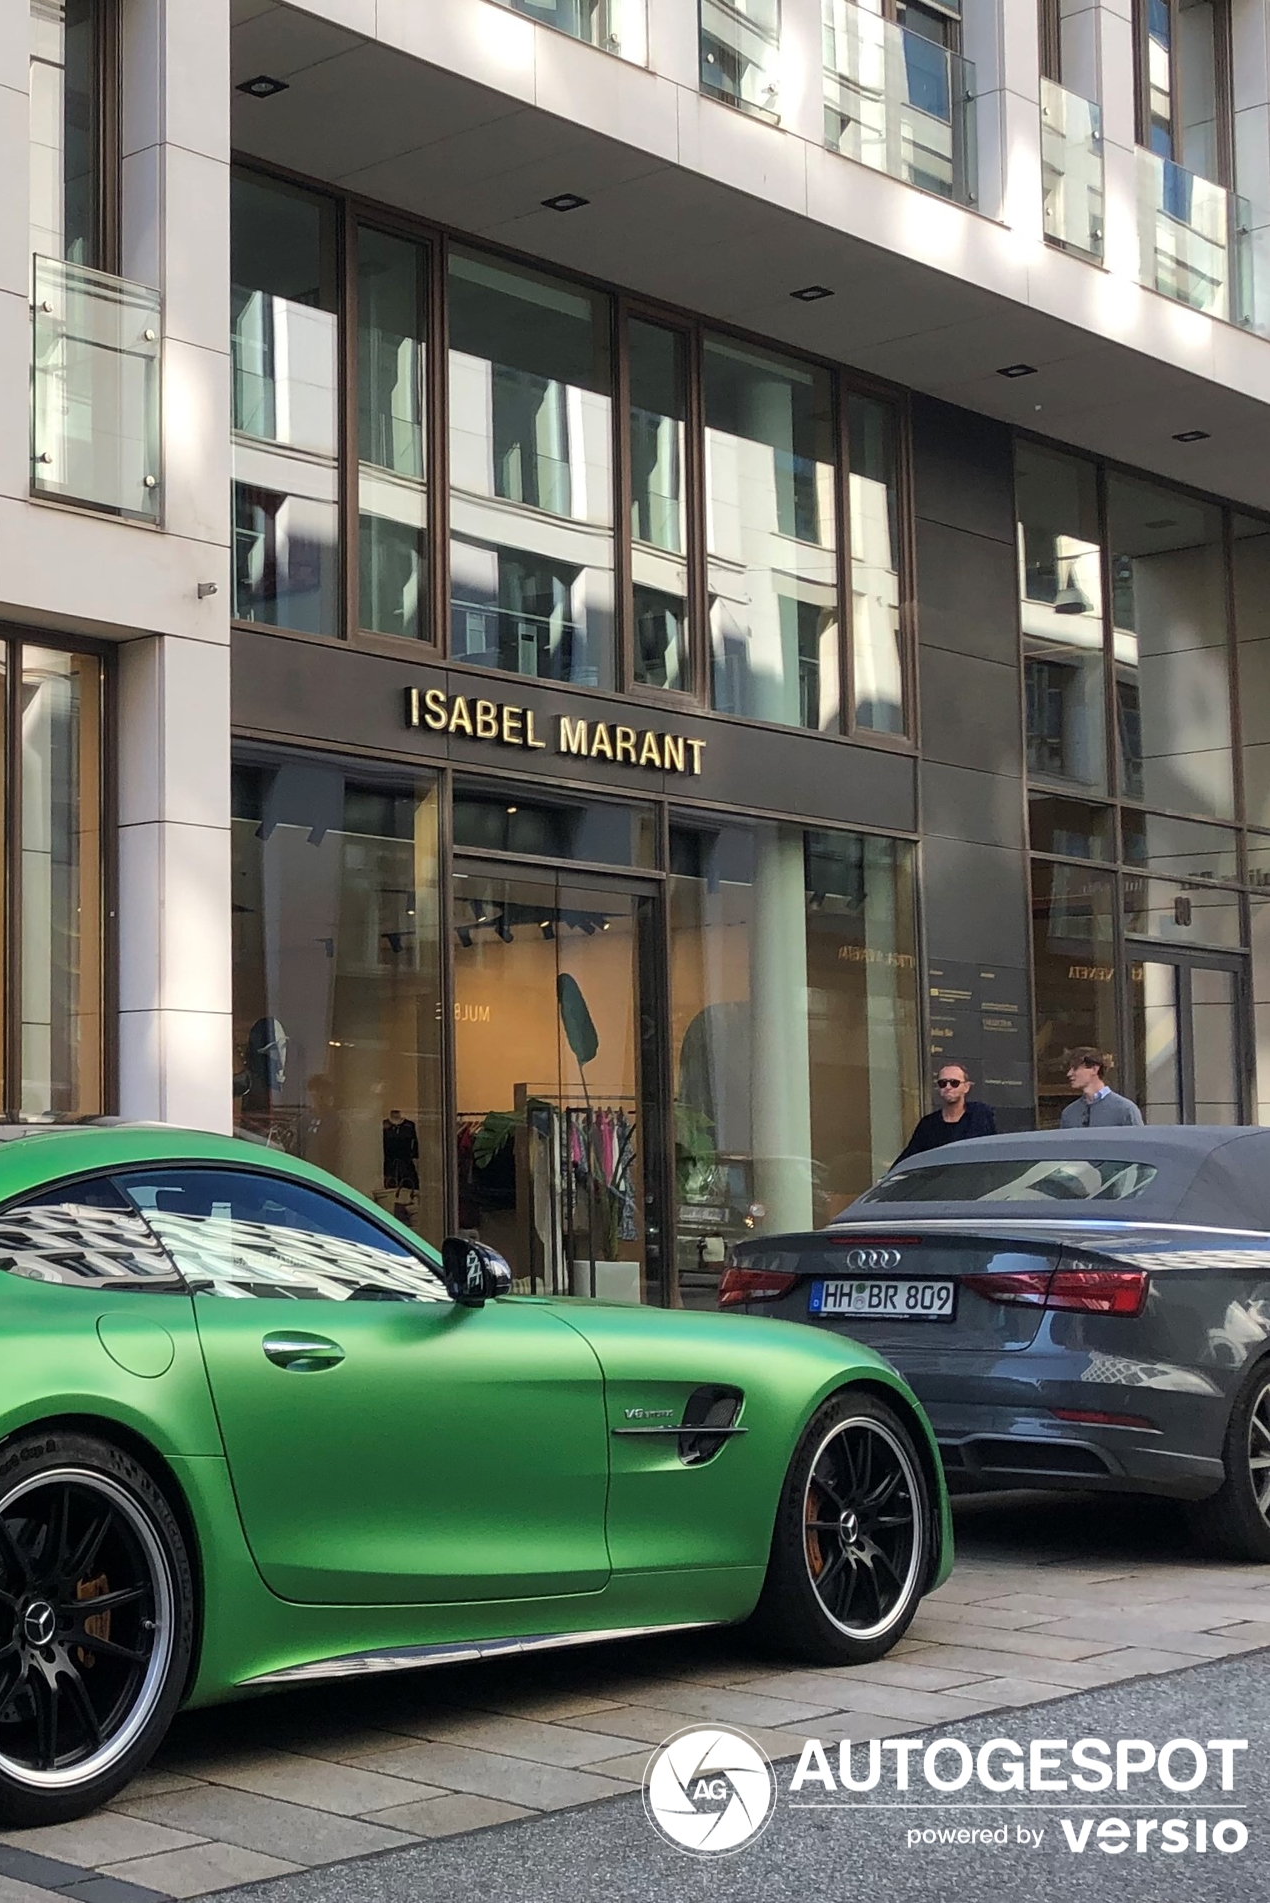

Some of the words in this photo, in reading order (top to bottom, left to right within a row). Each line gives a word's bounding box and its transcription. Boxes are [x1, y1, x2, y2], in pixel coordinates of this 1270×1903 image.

[407, 686, 546, 749] ISABEL
[558, 714, 707, 776] MARANT
[824, 1283, 853, 1308] HH
[868, 1284, 899, 1309] BR
[905, 1285, 951, 1311] 809
